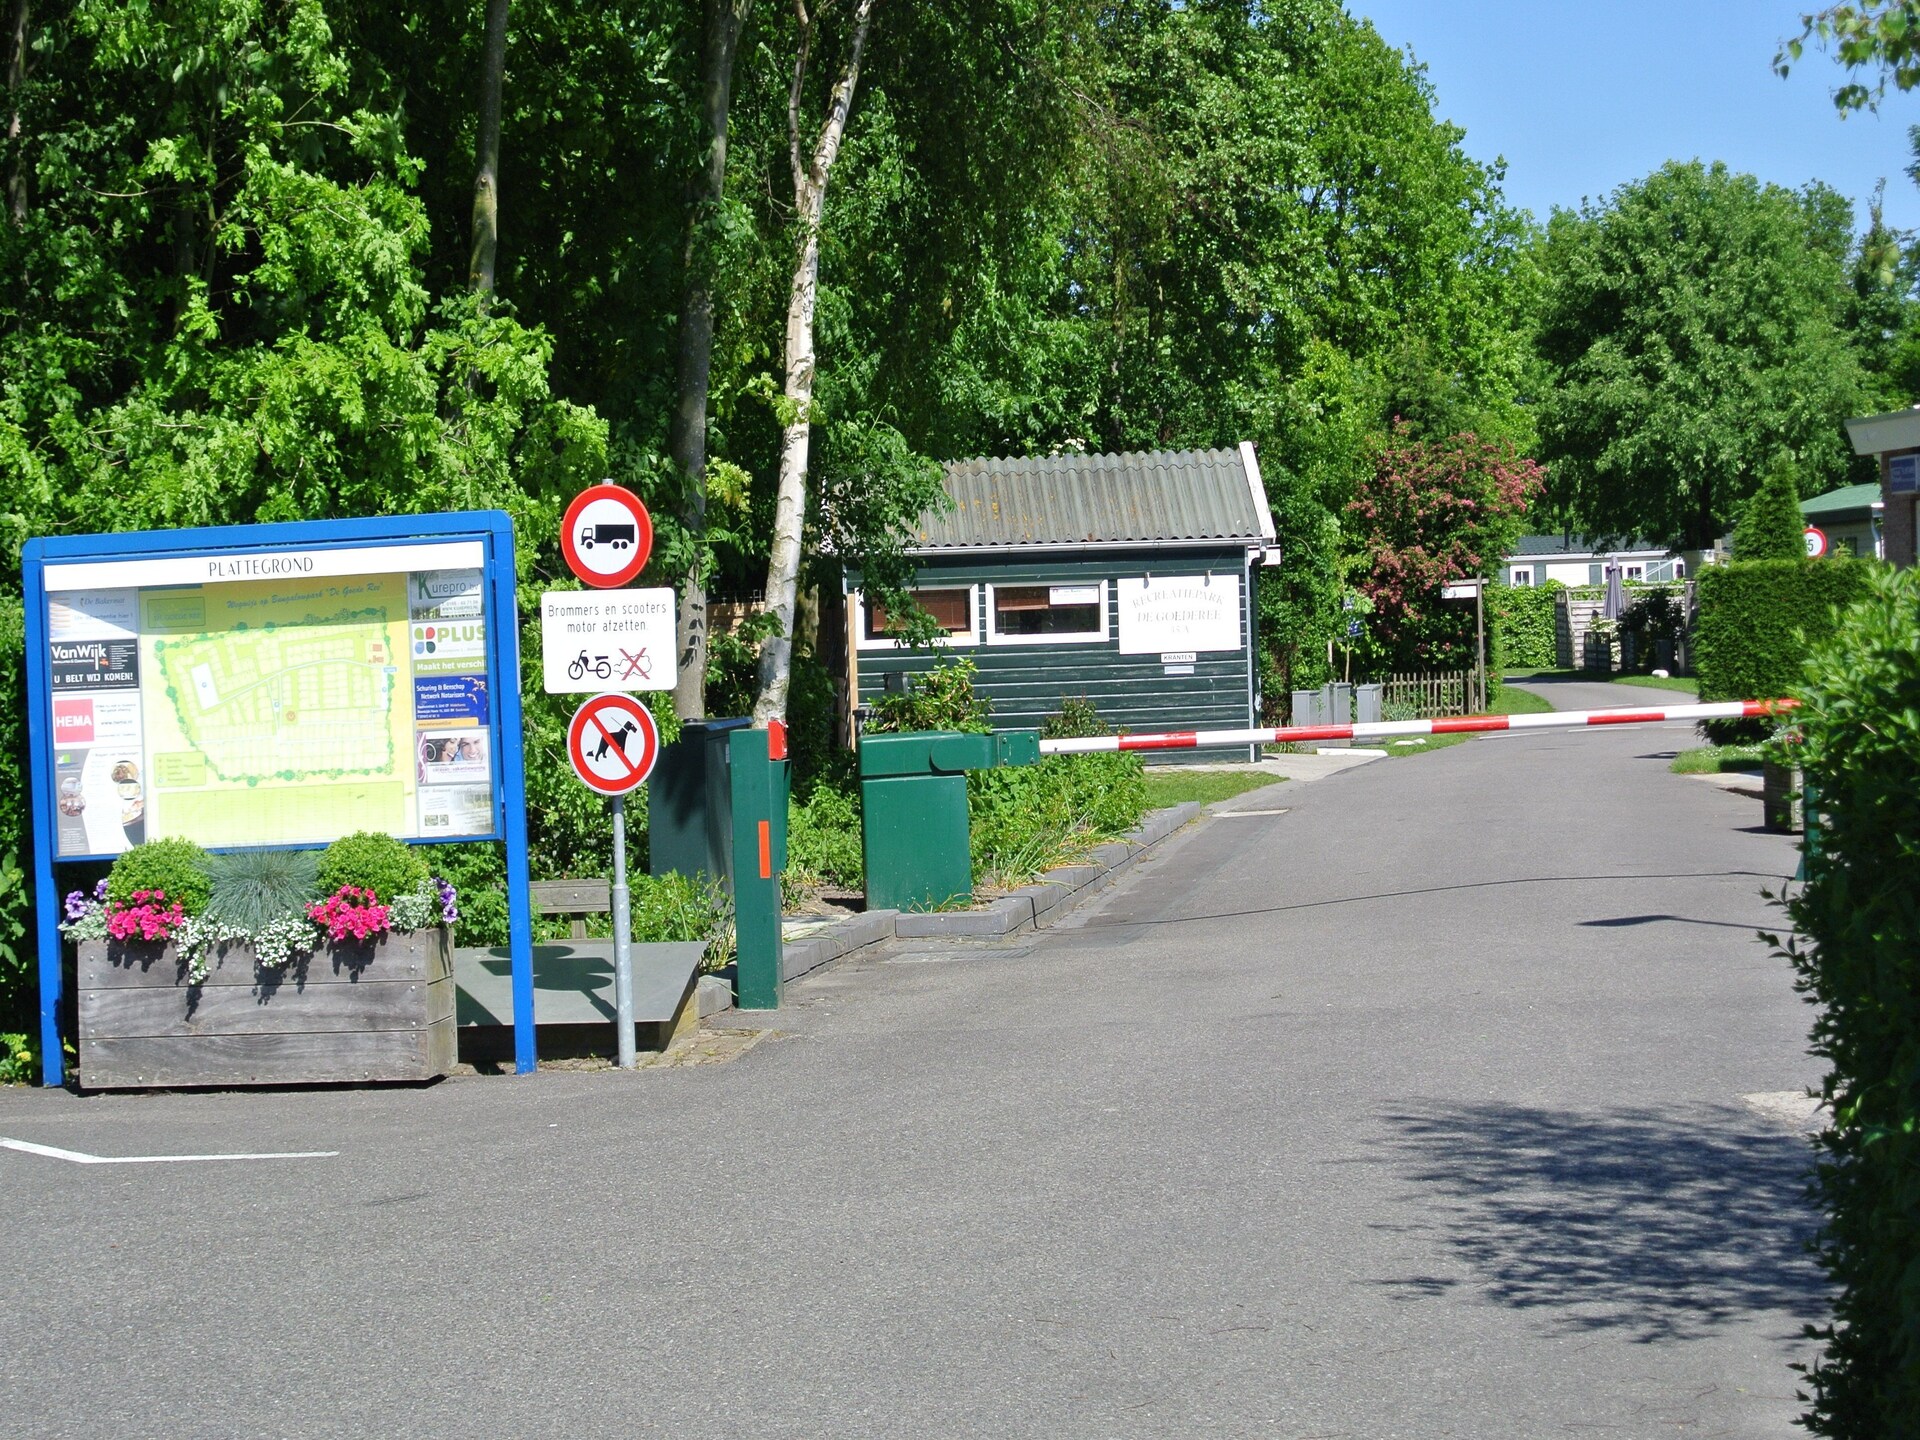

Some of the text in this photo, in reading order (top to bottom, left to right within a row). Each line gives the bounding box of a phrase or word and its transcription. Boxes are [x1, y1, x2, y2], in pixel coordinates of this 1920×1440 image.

[209, 557, 314, 577] PLATTEGROND
[418, 572, 466, 600] Kurepro
[548, 602, 667, 617] Brommers en scooters
[567, 620, 597, 633] motor
[437, 625, 486, 642] PLUS
[417, 662, 441, 671] Maakt
[442, 661, 455, 669] het
[53, 672, 134, 684] U BELT WIJ KOMEN!
[416, 684, 438, 692] Schuring
[420, 692, 441, 700] Netwerk
[56, 715, 92, 727] HEMA
